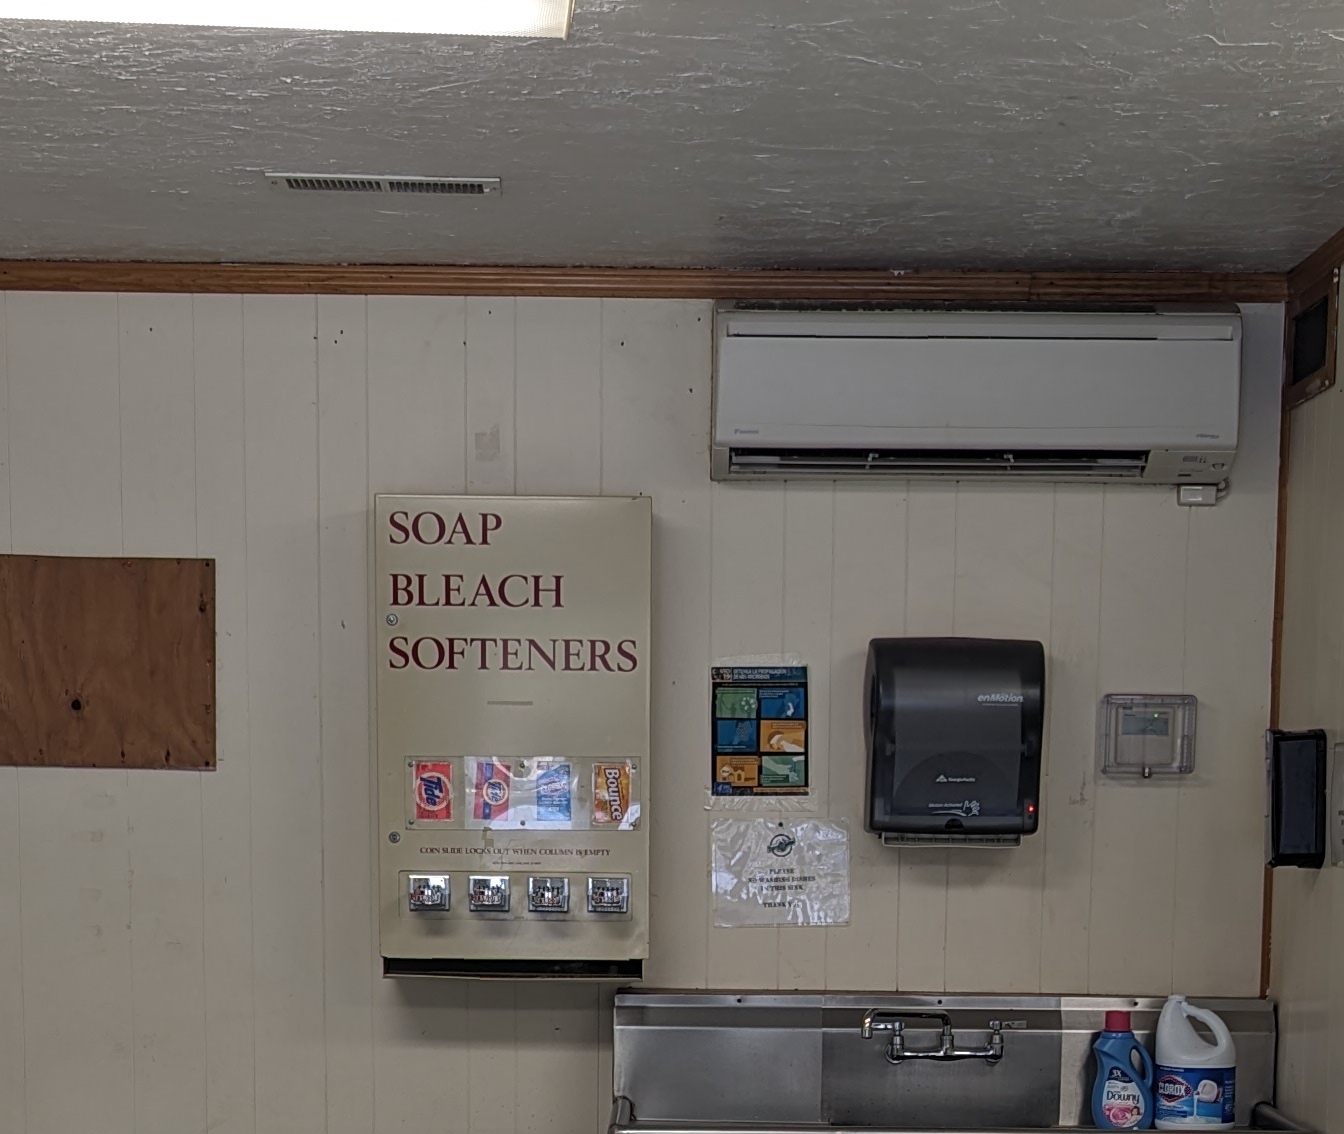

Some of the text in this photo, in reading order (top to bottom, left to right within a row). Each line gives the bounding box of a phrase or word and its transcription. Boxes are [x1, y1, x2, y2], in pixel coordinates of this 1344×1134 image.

[388, 510, 502, 546] SOAP
[388, 572, 565, 608] BLEACH
[388, 636, 638, 673] SOFTENERS
[977, 693, 1024, 703] enMotion
[420, 775, 444, 807] Tide
[604, 767, 623, 821] Bounce
[419, 846, 440, 855] COIN
[465, 847, 492, 855] LOCKS
[512, 847, 537, 856] WHEN
[584, 848, 611, 857] EMPTY
[1106, 1090, 1140, 1105] Downy
[1158, 1081, 1186, 1096] CLOROX
